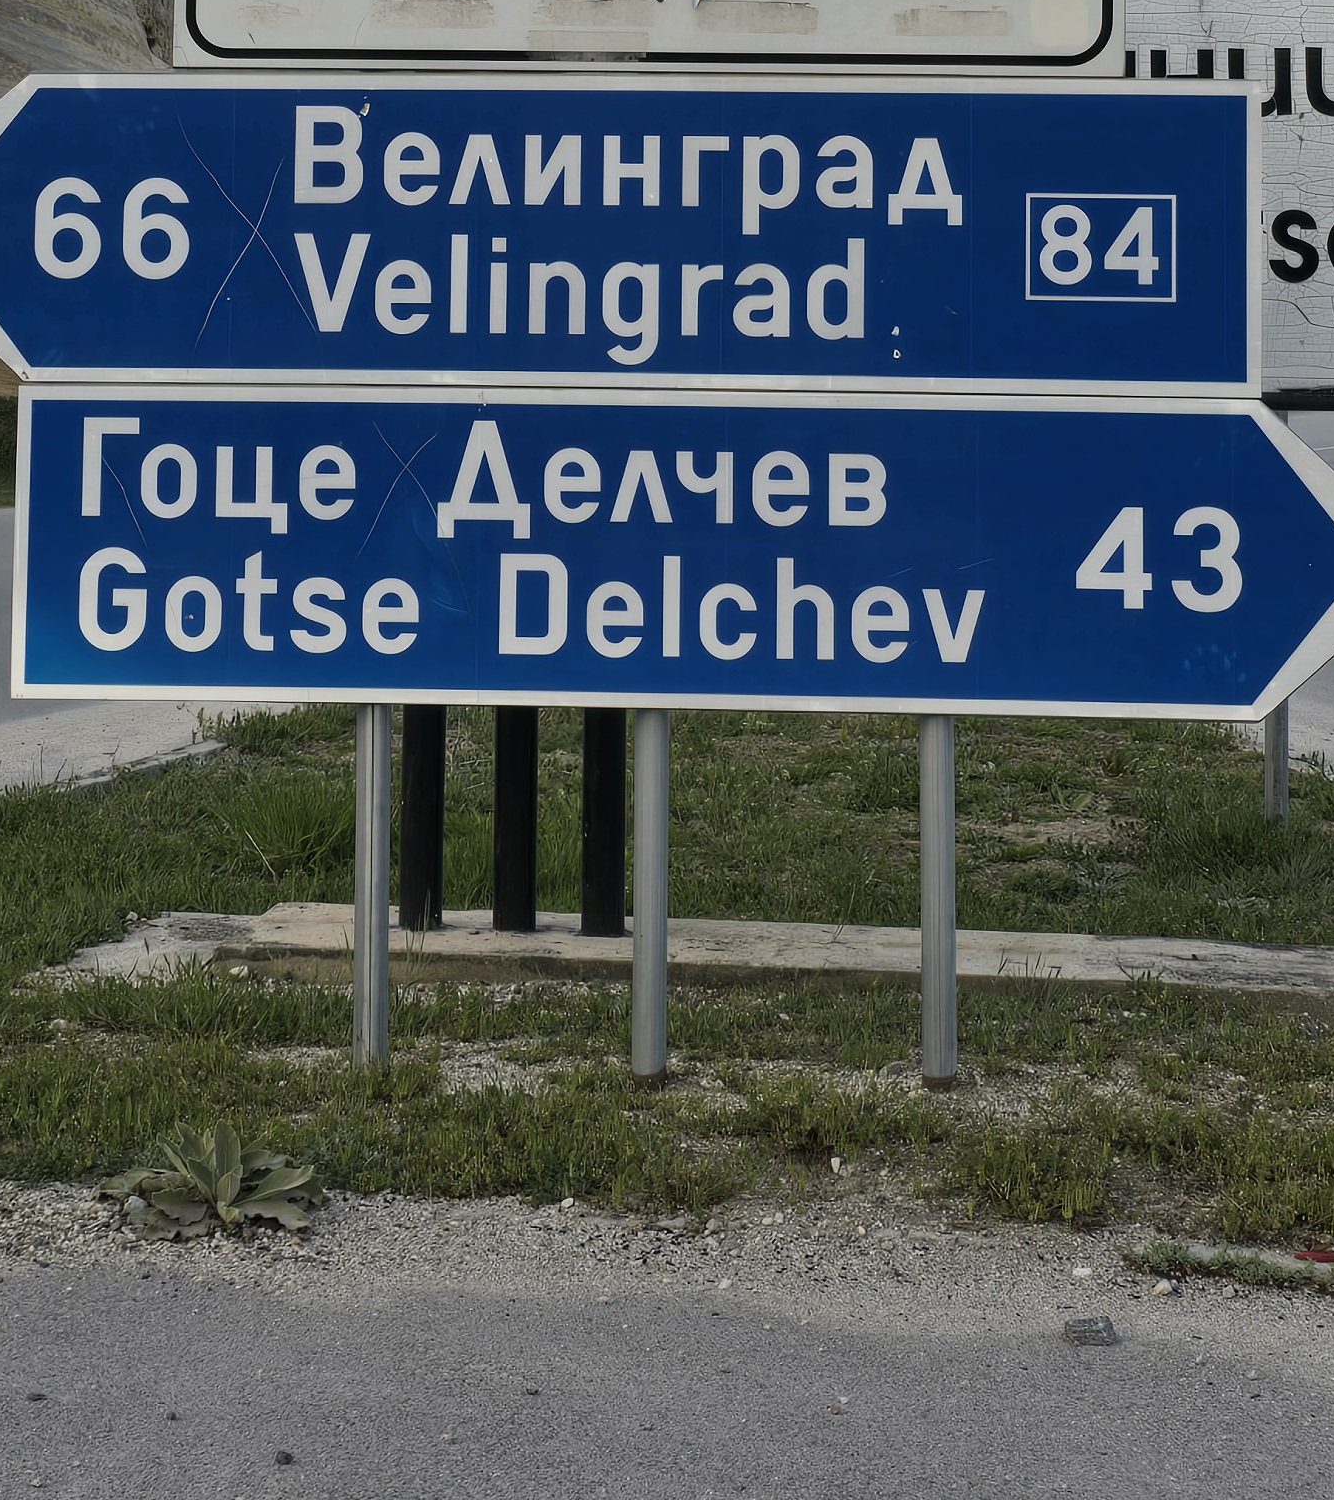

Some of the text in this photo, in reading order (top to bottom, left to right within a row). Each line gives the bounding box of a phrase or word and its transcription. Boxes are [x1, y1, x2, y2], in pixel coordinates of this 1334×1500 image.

[34, 176, 190, 280] 66
[293, 103, 963, 235] Велинград
[293, 234, 865, 366] Velingrad
[1039, 204, 1159, 286] 84
[81, 416, 887, 540] Гоце Делчев
[78, 546, 986, 664] Gotse Delchev
[1075, 506, 1243, 614] 43
